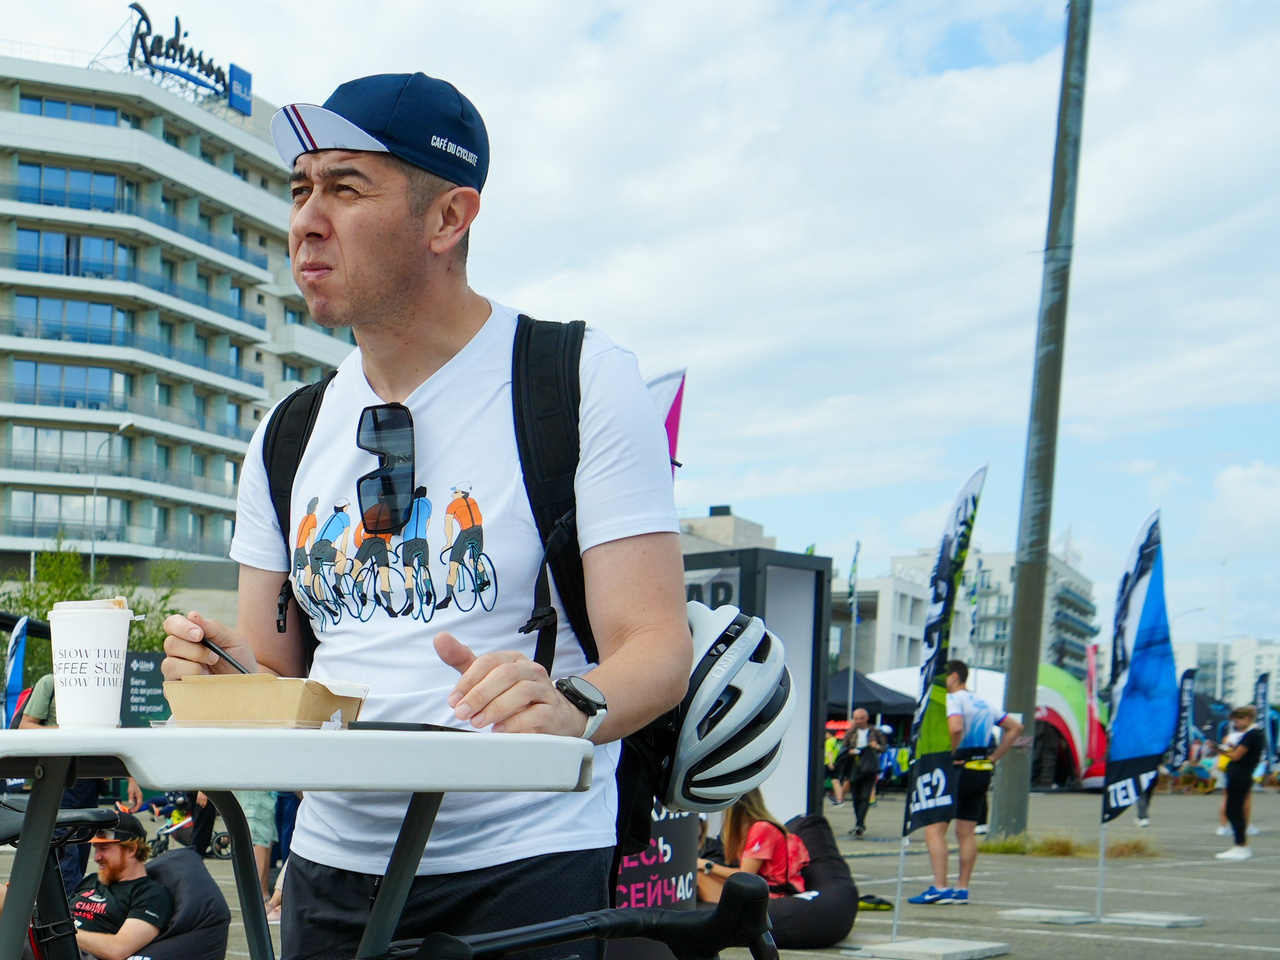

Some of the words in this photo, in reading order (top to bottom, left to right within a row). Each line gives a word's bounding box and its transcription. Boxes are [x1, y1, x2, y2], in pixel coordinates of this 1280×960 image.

[128, 3, 230, 99] Radisson
[431, 135, 448, 151] CAFÉ
[447, 141, 457, 155] DU
[455, 145, 478, 167] CYCLISTE
[58, 648, 91, 659] SLOW
[93, 648, 121, 659] TIME
[60, 677, 91, 687] SLOW
[94, 677, 119, 687] TIME
[618, 836, 672, 875] ЕСЬ
[616, 871, 694, 910] СЕЙЧАС
